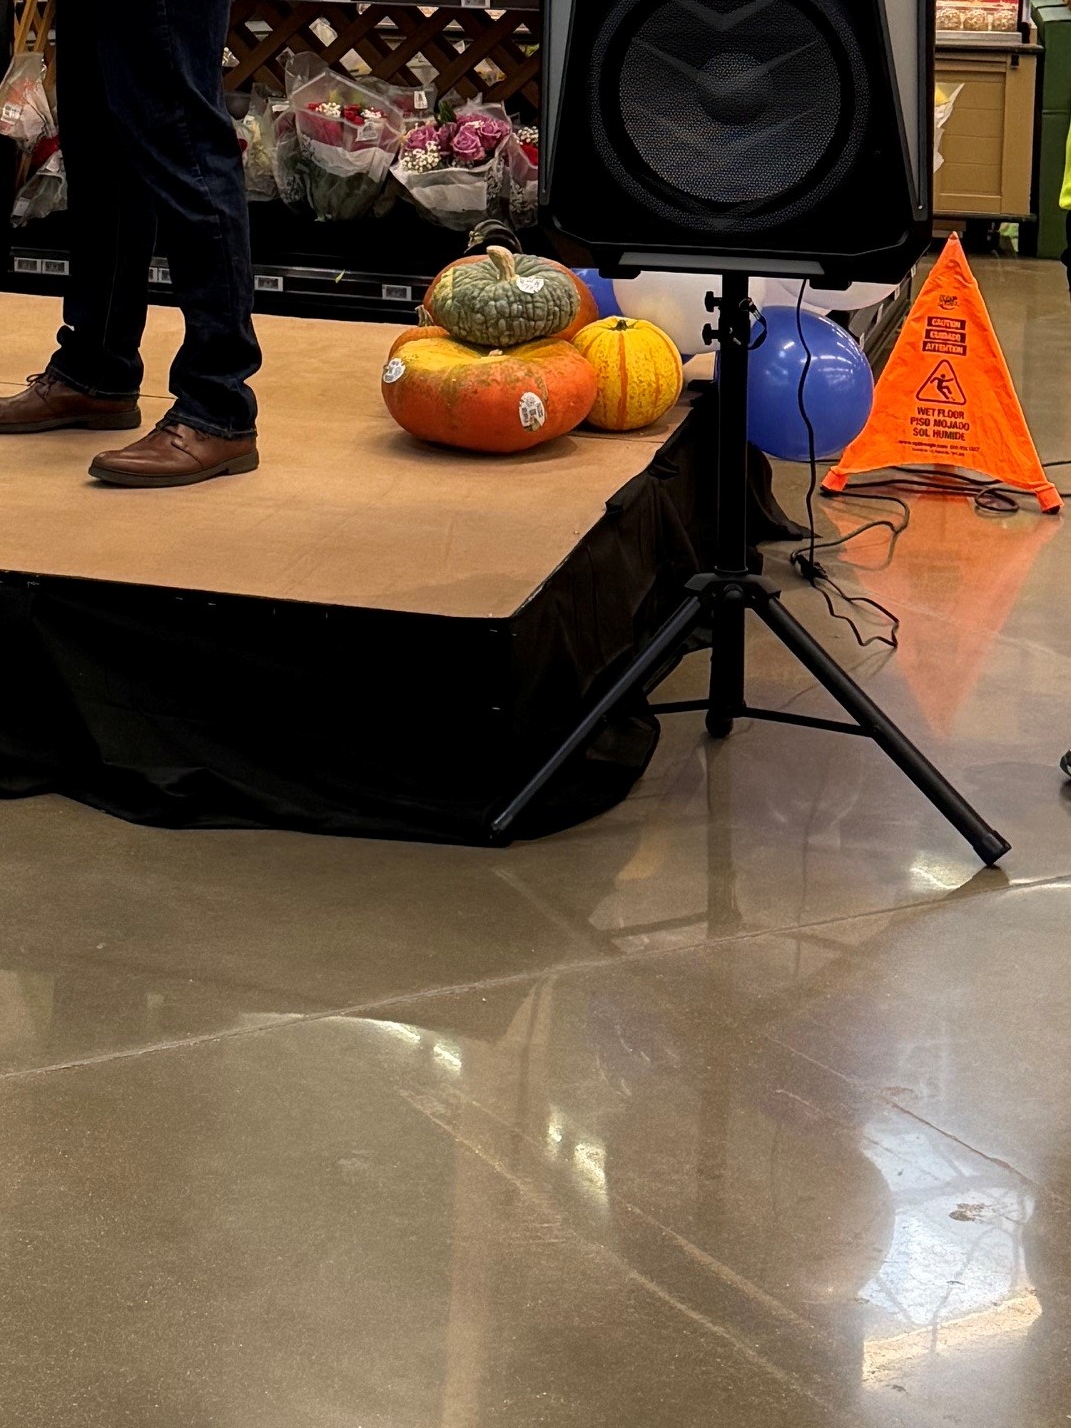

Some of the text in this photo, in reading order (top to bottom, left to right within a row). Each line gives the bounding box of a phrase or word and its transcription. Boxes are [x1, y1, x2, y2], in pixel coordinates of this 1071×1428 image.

[931, 318, 961, 329] CAUTION
[929, 330, 961, 342] CUIDADO
[925, 342, 964, 354] ATTENTION
[917, 406, 965, 420] WET FLOOR
[910, 416, 970, 431] PISO MOJADO
[912, 427, 966, 441] SOL HUMIDE
